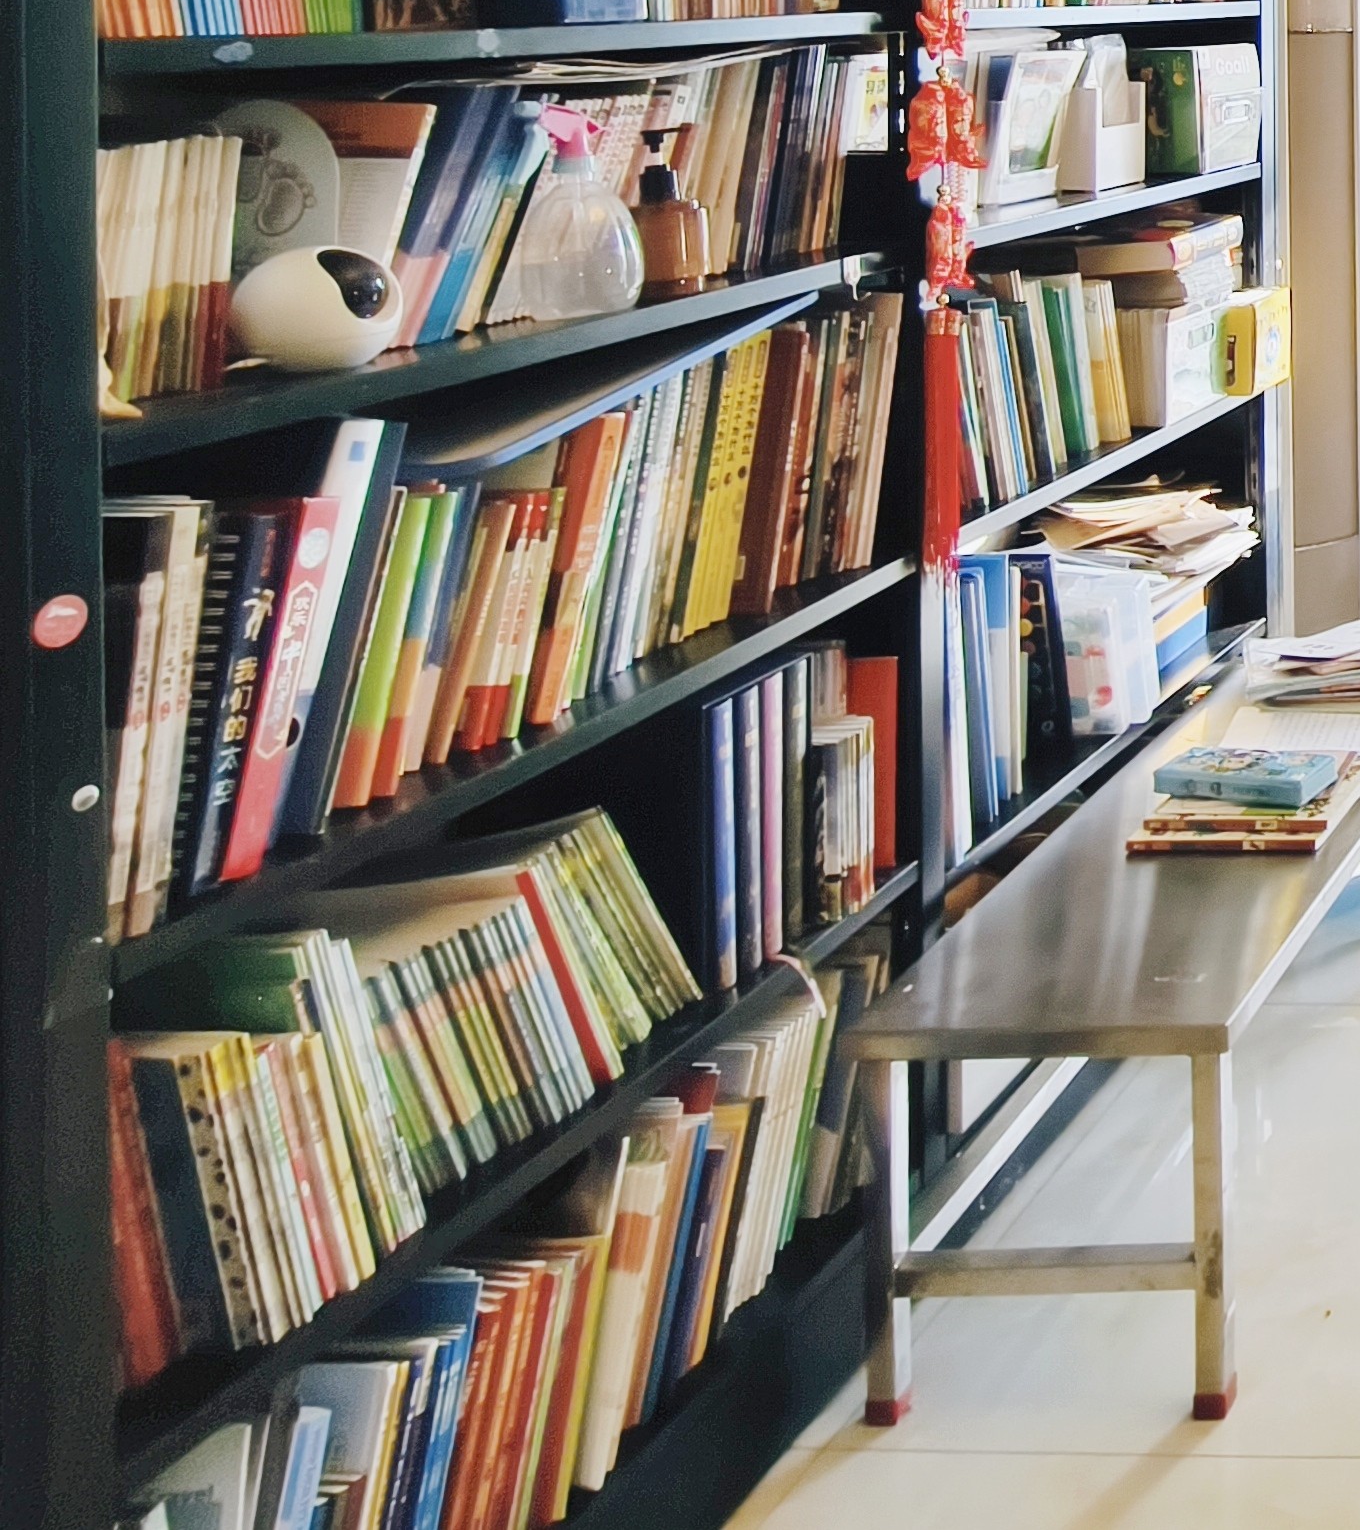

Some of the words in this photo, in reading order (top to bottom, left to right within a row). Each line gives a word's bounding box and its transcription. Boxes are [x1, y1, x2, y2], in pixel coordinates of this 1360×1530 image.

[727, 388, 747, 462] 十万个为什么
[742, 381, 761, 456] 十万个为什么
[213, 656, 258, 806] 我们的太空
